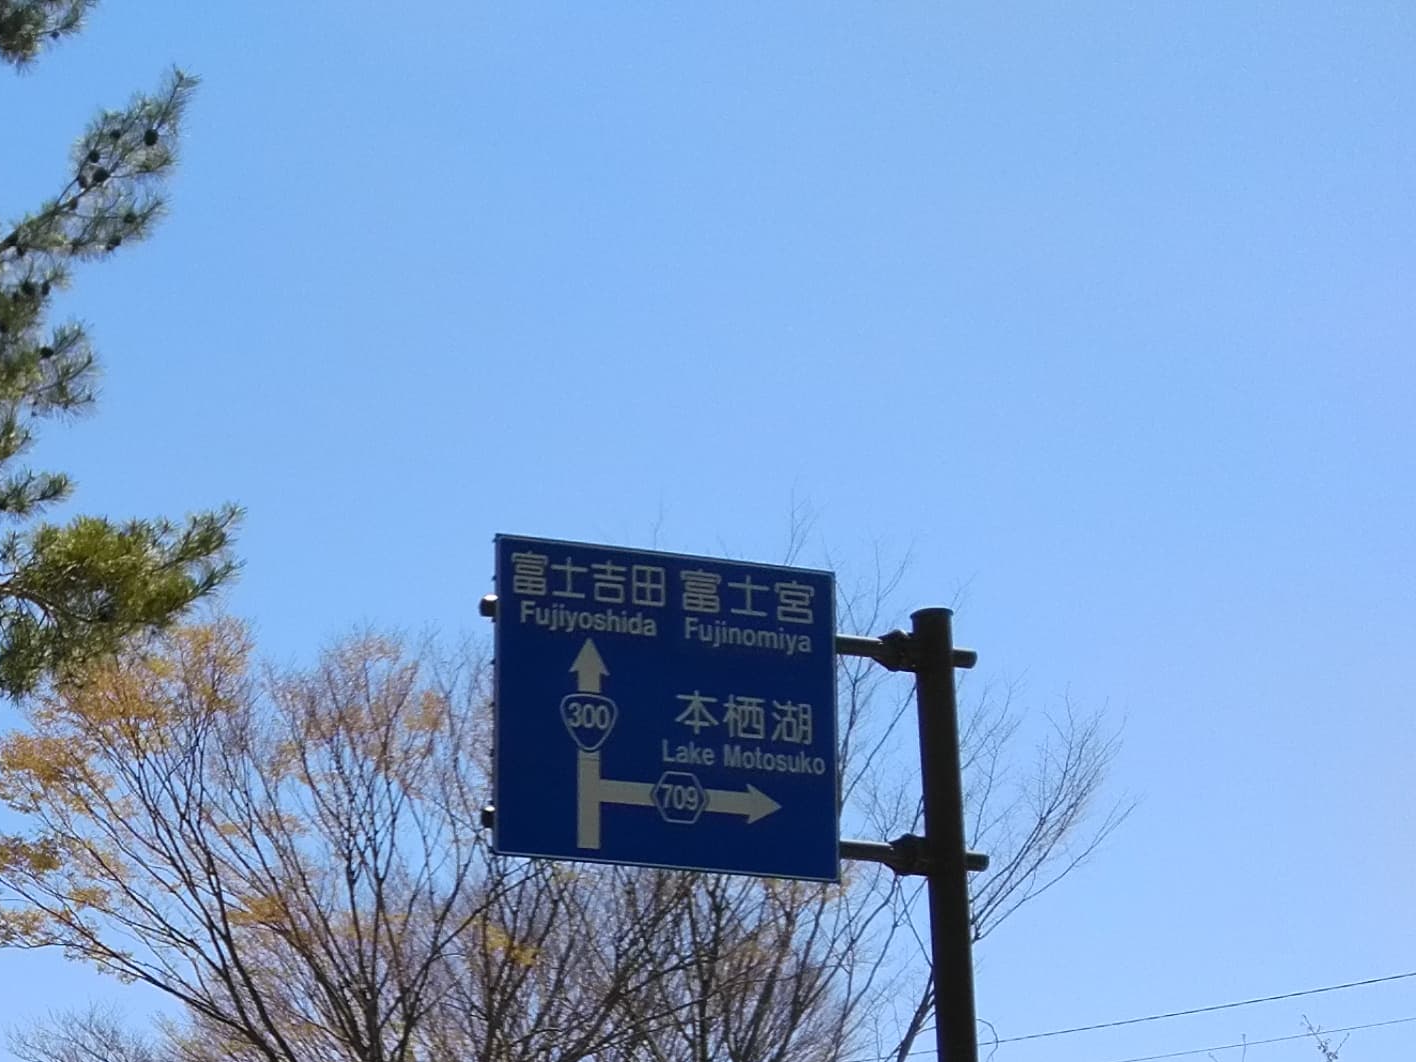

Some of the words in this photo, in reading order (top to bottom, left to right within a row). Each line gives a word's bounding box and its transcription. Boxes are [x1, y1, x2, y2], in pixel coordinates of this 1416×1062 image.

[511, 550, 666, 607] 富士吉田
[680, 568, 814, 625] 富士宮
[520, 600, 657, 637] Fujiyoshida
[685, 616, 812, 655] Fujinomiya
[567, 702, 611, 730] 300
[675, 690, 813, 745] 本栖湖
[661, 739, 716, 766] Lake
[723, 745, 826, 775] Motosuko
[660, 784, 700, 811] 709
